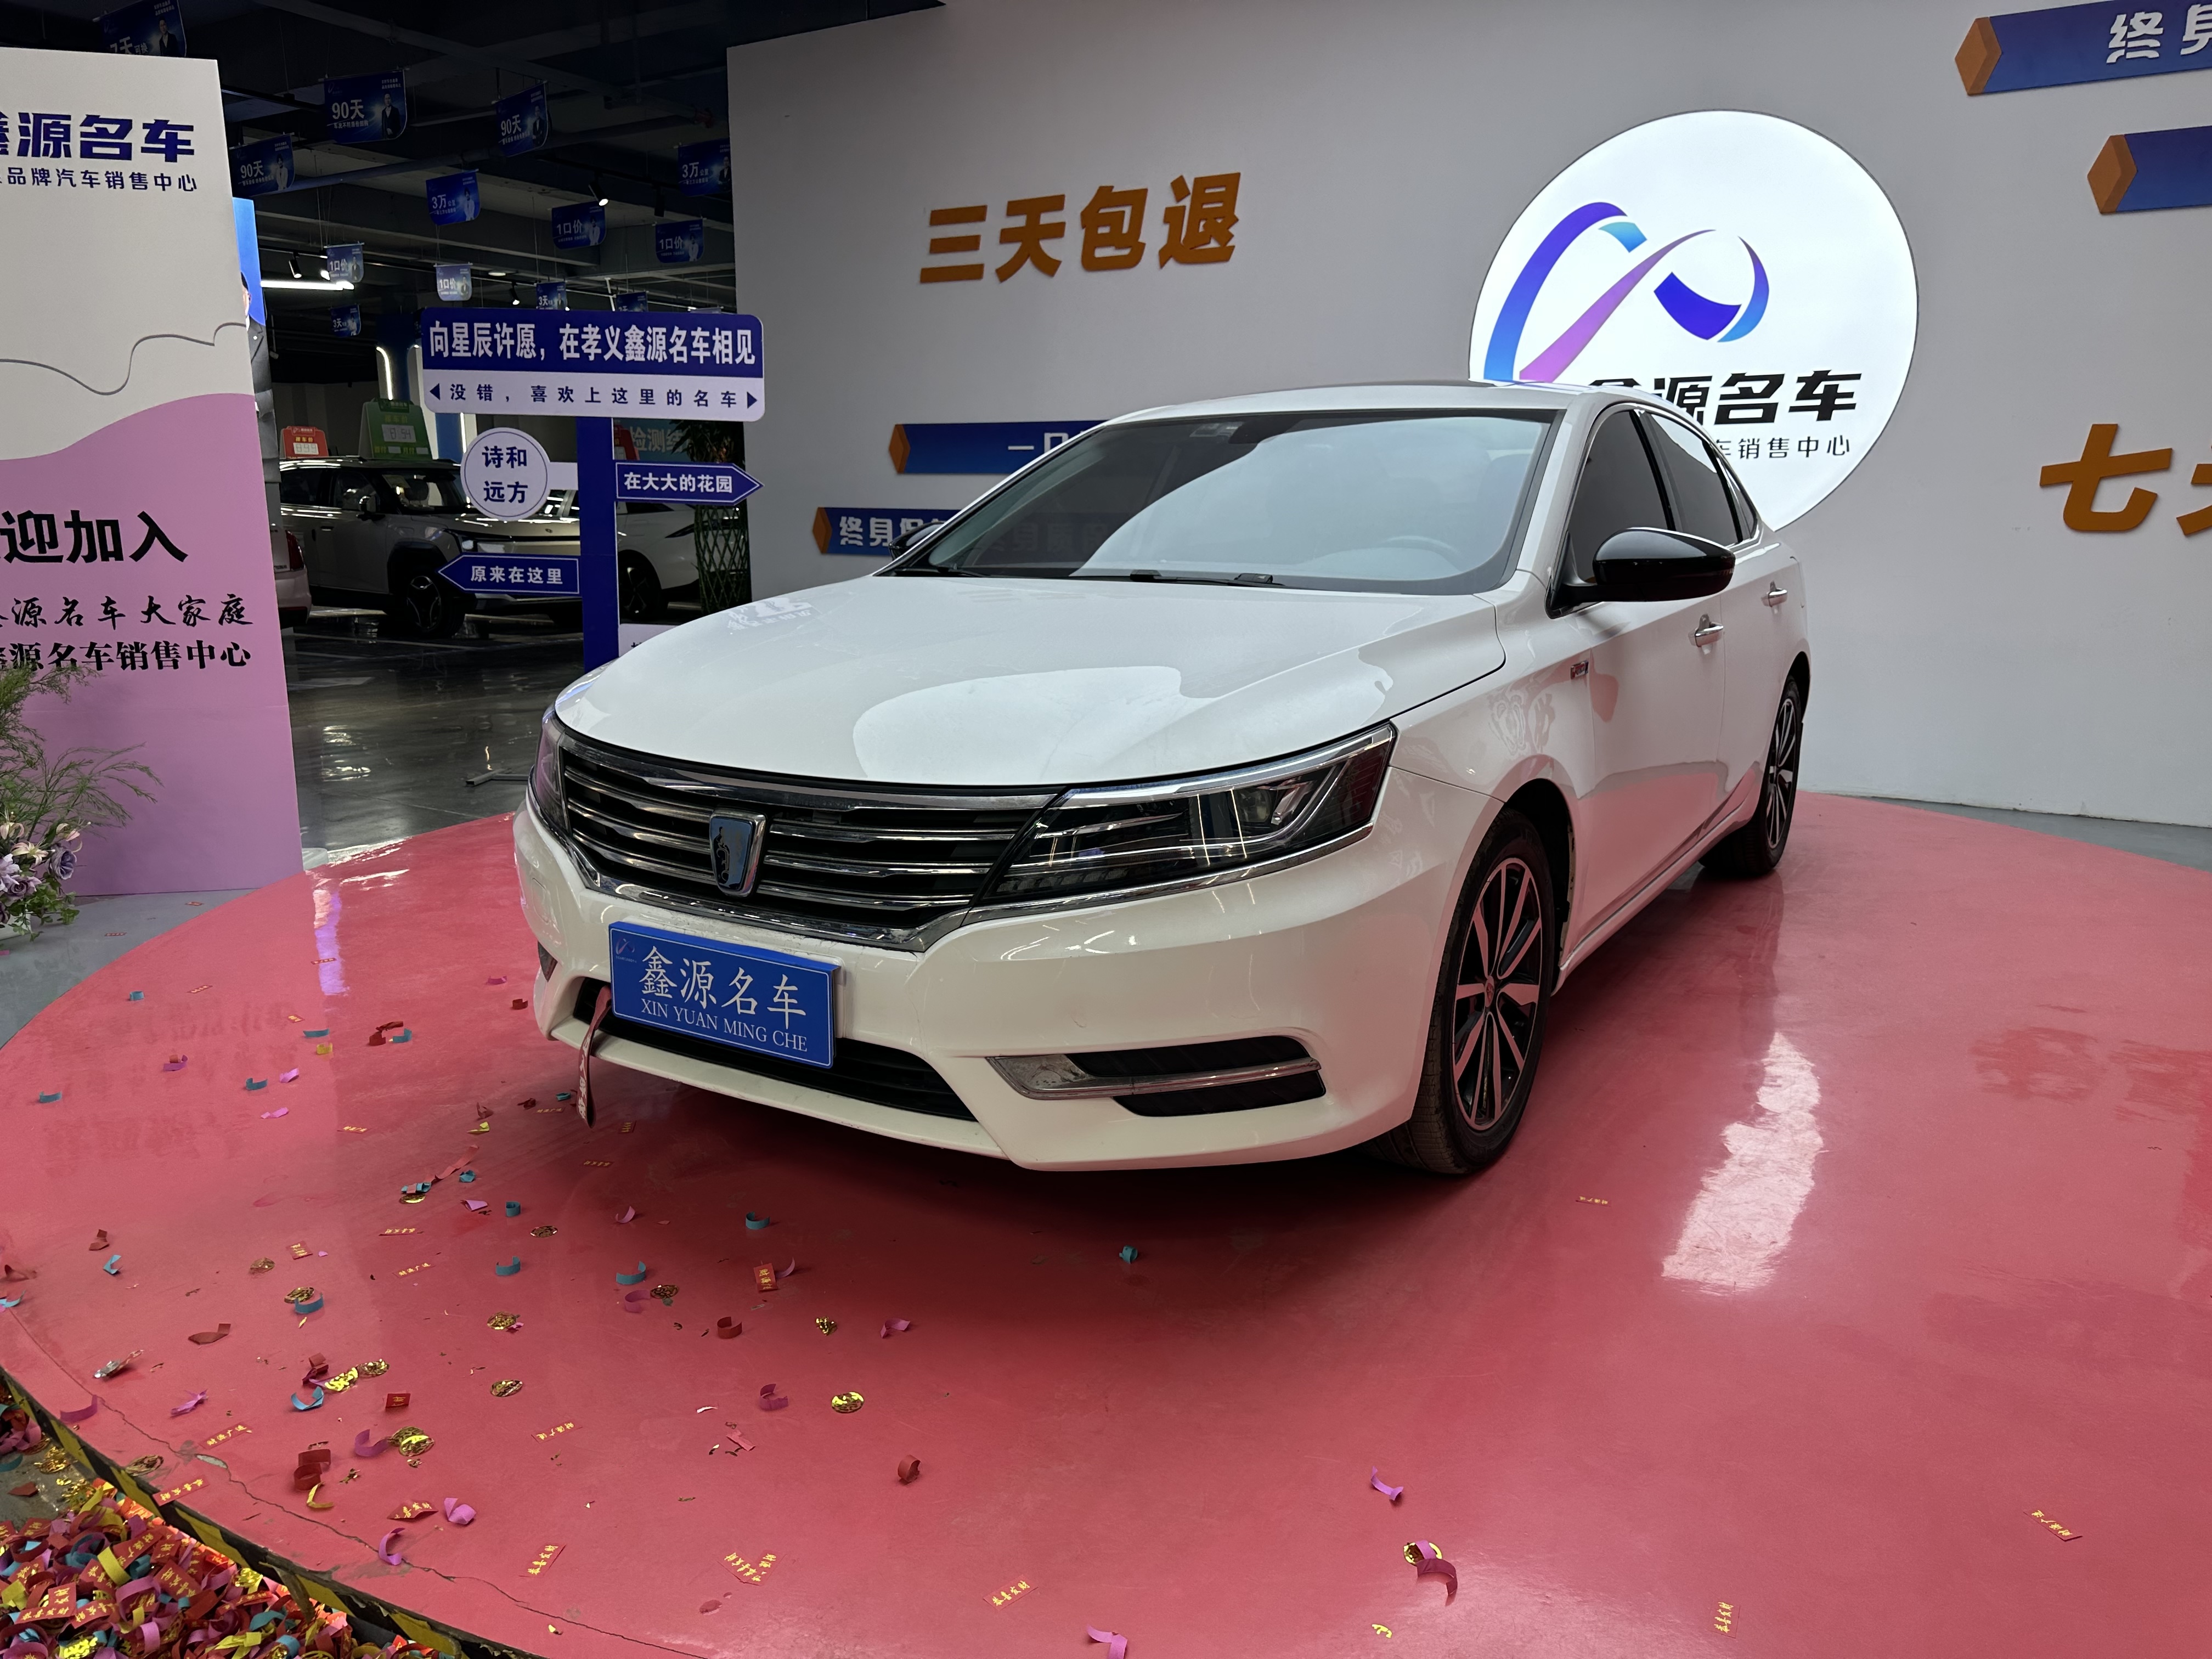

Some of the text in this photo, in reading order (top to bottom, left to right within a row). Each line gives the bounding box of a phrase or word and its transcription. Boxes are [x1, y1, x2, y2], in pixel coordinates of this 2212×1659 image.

[332, 99, 365, 120] 90天
[0, 111, 195, 163] 源名车
[500, 114, 522, 136] 90天
[0, 167, 198, 192] 品牌汽车销售中心
[240, 160, 264, 179] 90天
[557, 219, 583, 235] 1口价
[919, 173, 1241, 283] 三天包退
[659, 236, 684, 250] 1口价
[330, 258, 348, 272] 1口价
[439, 277, 456, 290] 1口价
[430, 320, 755, 365] 向星辰许愿，在孝义鑫源名车相见
[449, 383, 737, 408] 没错，喜欢上这里的名车
[1590, 369, 1863, 425] 源名车
[1008, 431, 1086, 454] 一口
[482, 445, 528, 469] 诗和
[483, 481, 528, 504] 远方
[624, 471, 733, 494] 在大大的花园
[0, 510, 189, 564] 迎加入
[471, 565, 563, 584] 原来在这里
[0, 594, 253, 630] 源名车大家庭
[0, 640, 251, 671] 源名车销售中心
[639, 946, 806, 1029] 鑫源名车
[641, 998, 808, 1052] XIN YUAN MING CHE
[992, 1581, 1030, 1606] 恭喜发财
